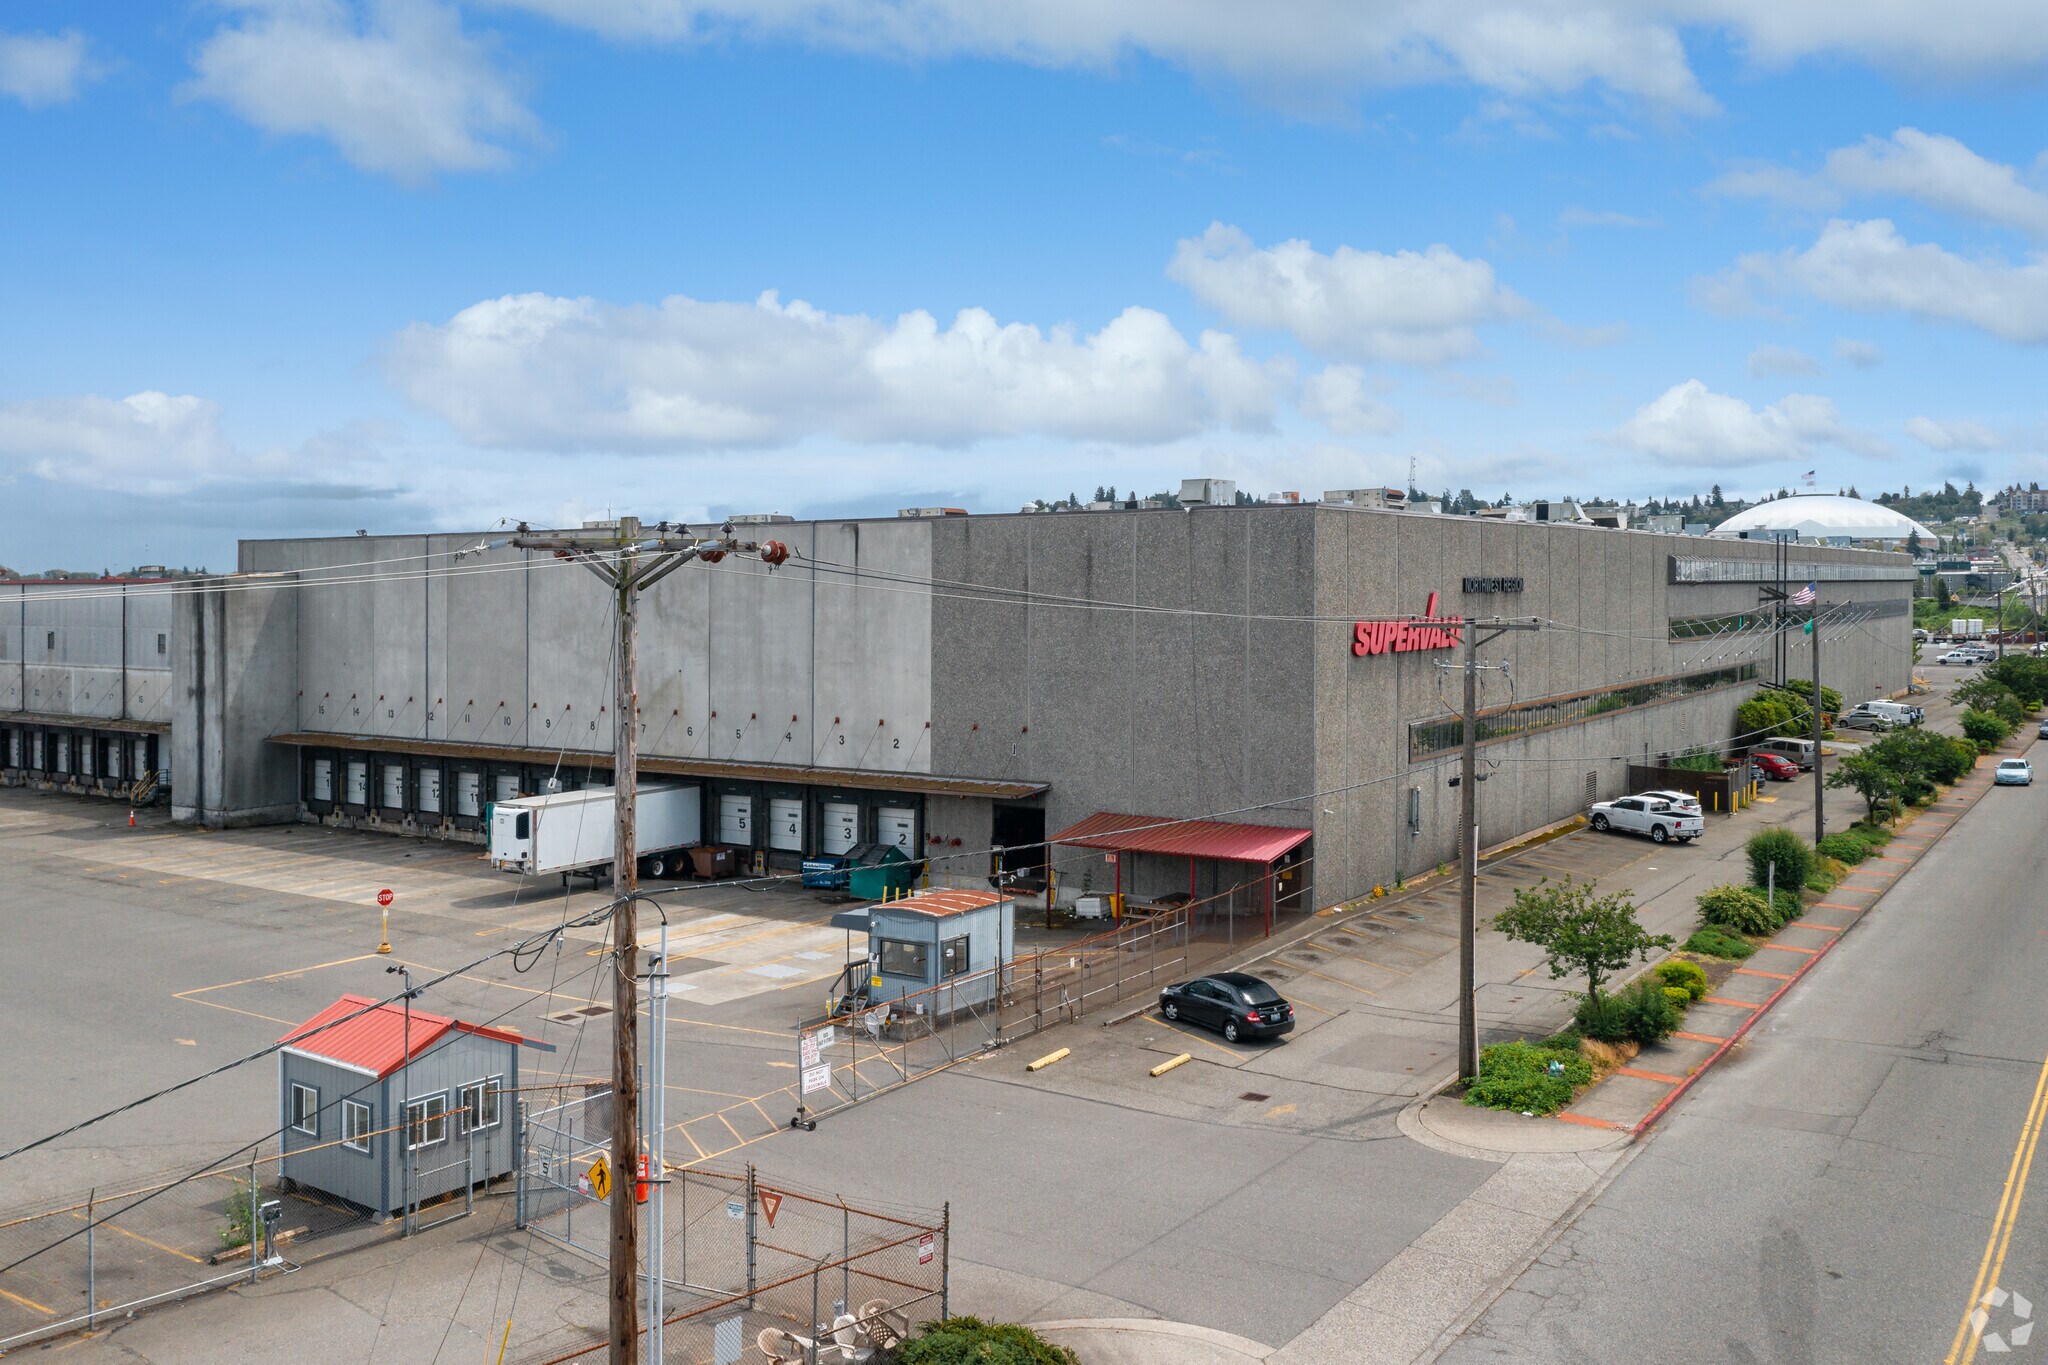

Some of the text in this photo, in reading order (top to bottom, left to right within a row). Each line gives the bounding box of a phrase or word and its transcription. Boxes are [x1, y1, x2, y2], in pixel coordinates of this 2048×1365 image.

[1463, 578, 1524, 593] NORTHWEST REGION
[1351, 592, 1463, 657] SUPERVALU
[318, 705, 325, 715] 15
[353, 707, 360, 716] 14
[388, 709, 394, 718] 13
[427, 712, 434, 721] 12
[464, 714, 470, 723] 11
[504, 716, 511, 726] 10
[545, 718, 551, 728] 9
[590, 721, 595, 731] 8
[641, 724, 647, 734] 7
[687, 726, 693, 737] 6
[736, 729, 741, 739] 5
[785, 732, 792, 743] 4
[839, 735, 845, 746] 3
[893, 738, 900, 749] 2
[739, 818, 746, 829] 5
[789, 823, 797, 835] 4
[844, 827, 852, 840] 3
[898, 833, 907, 846] 2
[378, 893, 393, 902] STOP
[543, 1162, 549, 1174] 5
